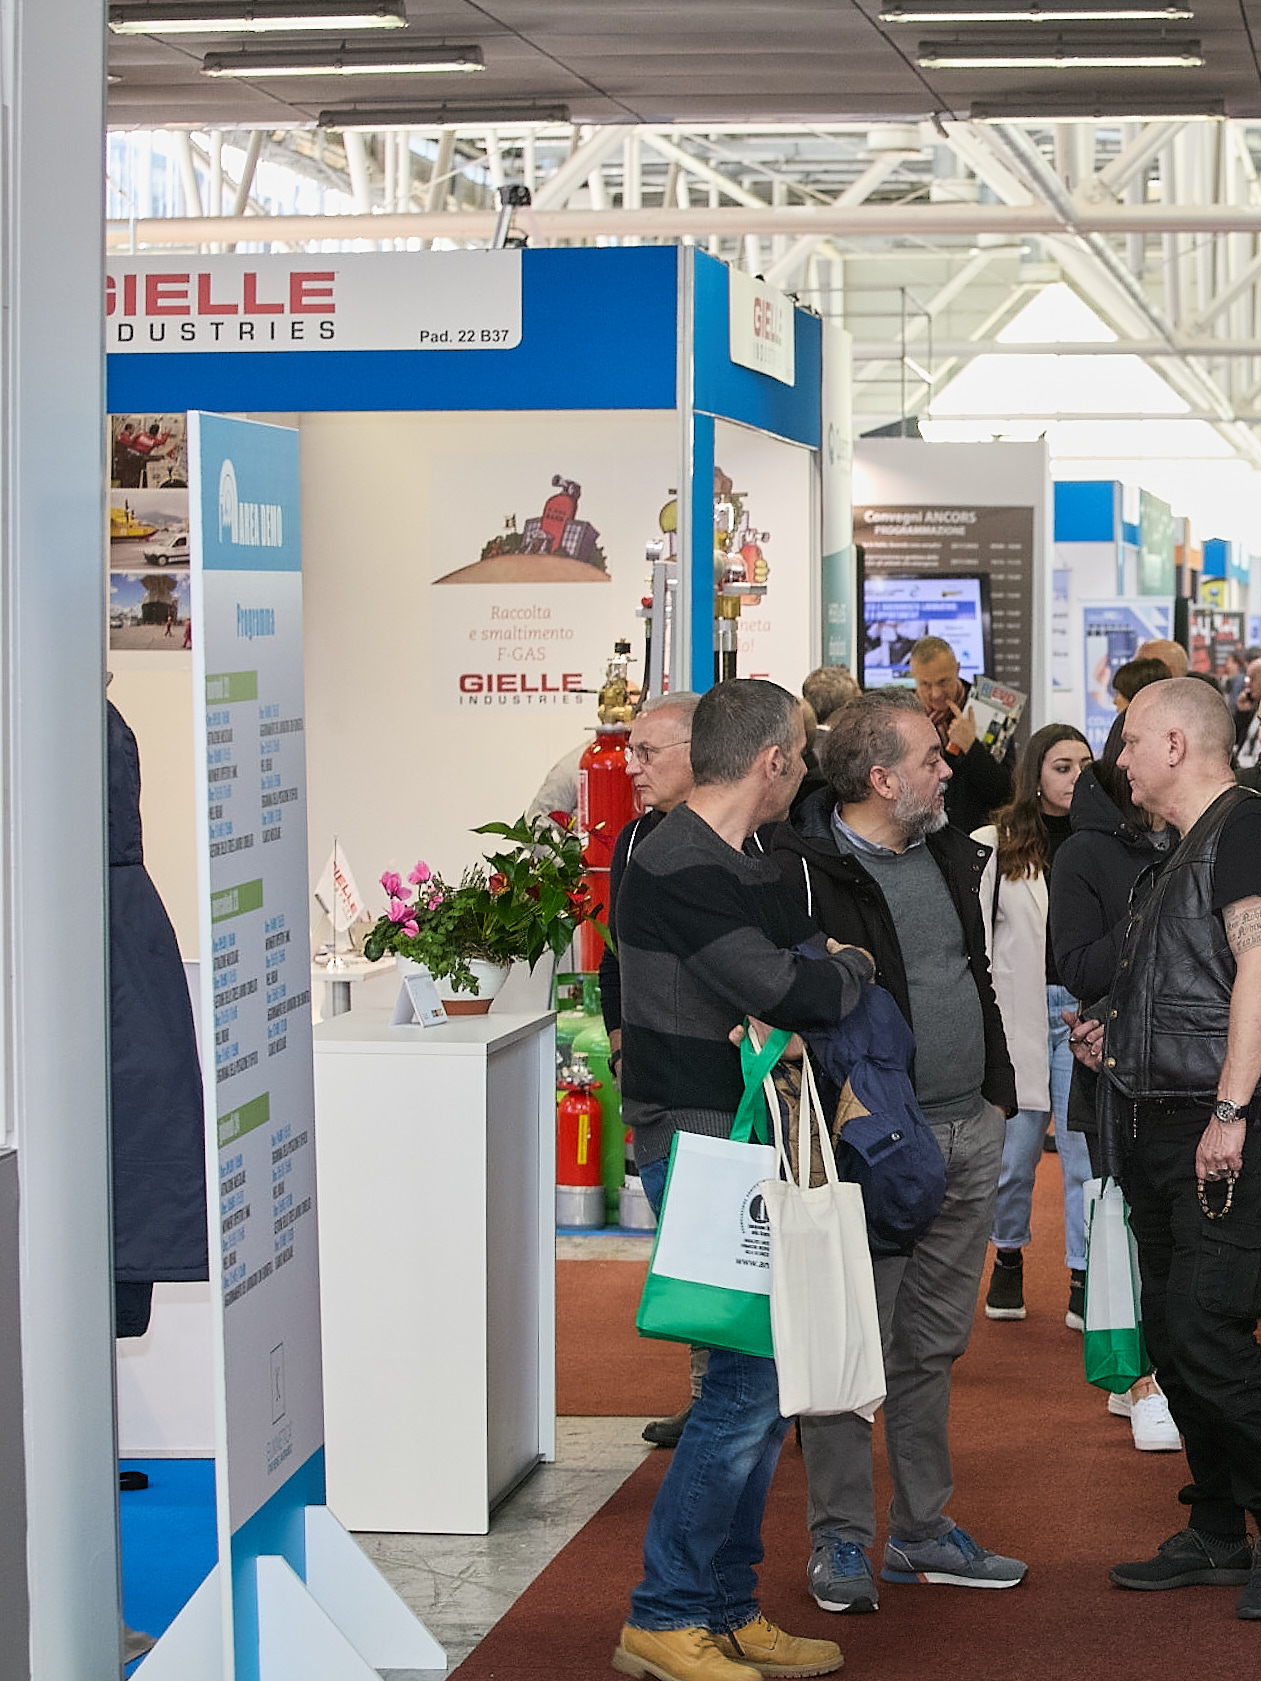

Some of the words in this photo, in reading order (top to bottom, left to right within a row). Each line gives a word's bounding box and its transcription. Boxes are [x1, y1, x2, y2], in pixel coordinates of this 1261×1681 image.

[106, 272, 335, 316] IELLE
[420, 330, 453, 343] Pad.
[458, 330, 476, 342] 22
[481, 329, 509, 342] B37
[924, 510, 977, 523] ANCORS
[491, 605, 551, 620] Raccolta
[469, 631, 477, 640] e
[481, 625, 574, 640] smaltimento
[497, 647, 546, 661] F-GAS
[459, 673, 583, 693] GIELLE
[459, 695, 583, 705] INDUSTRIES
